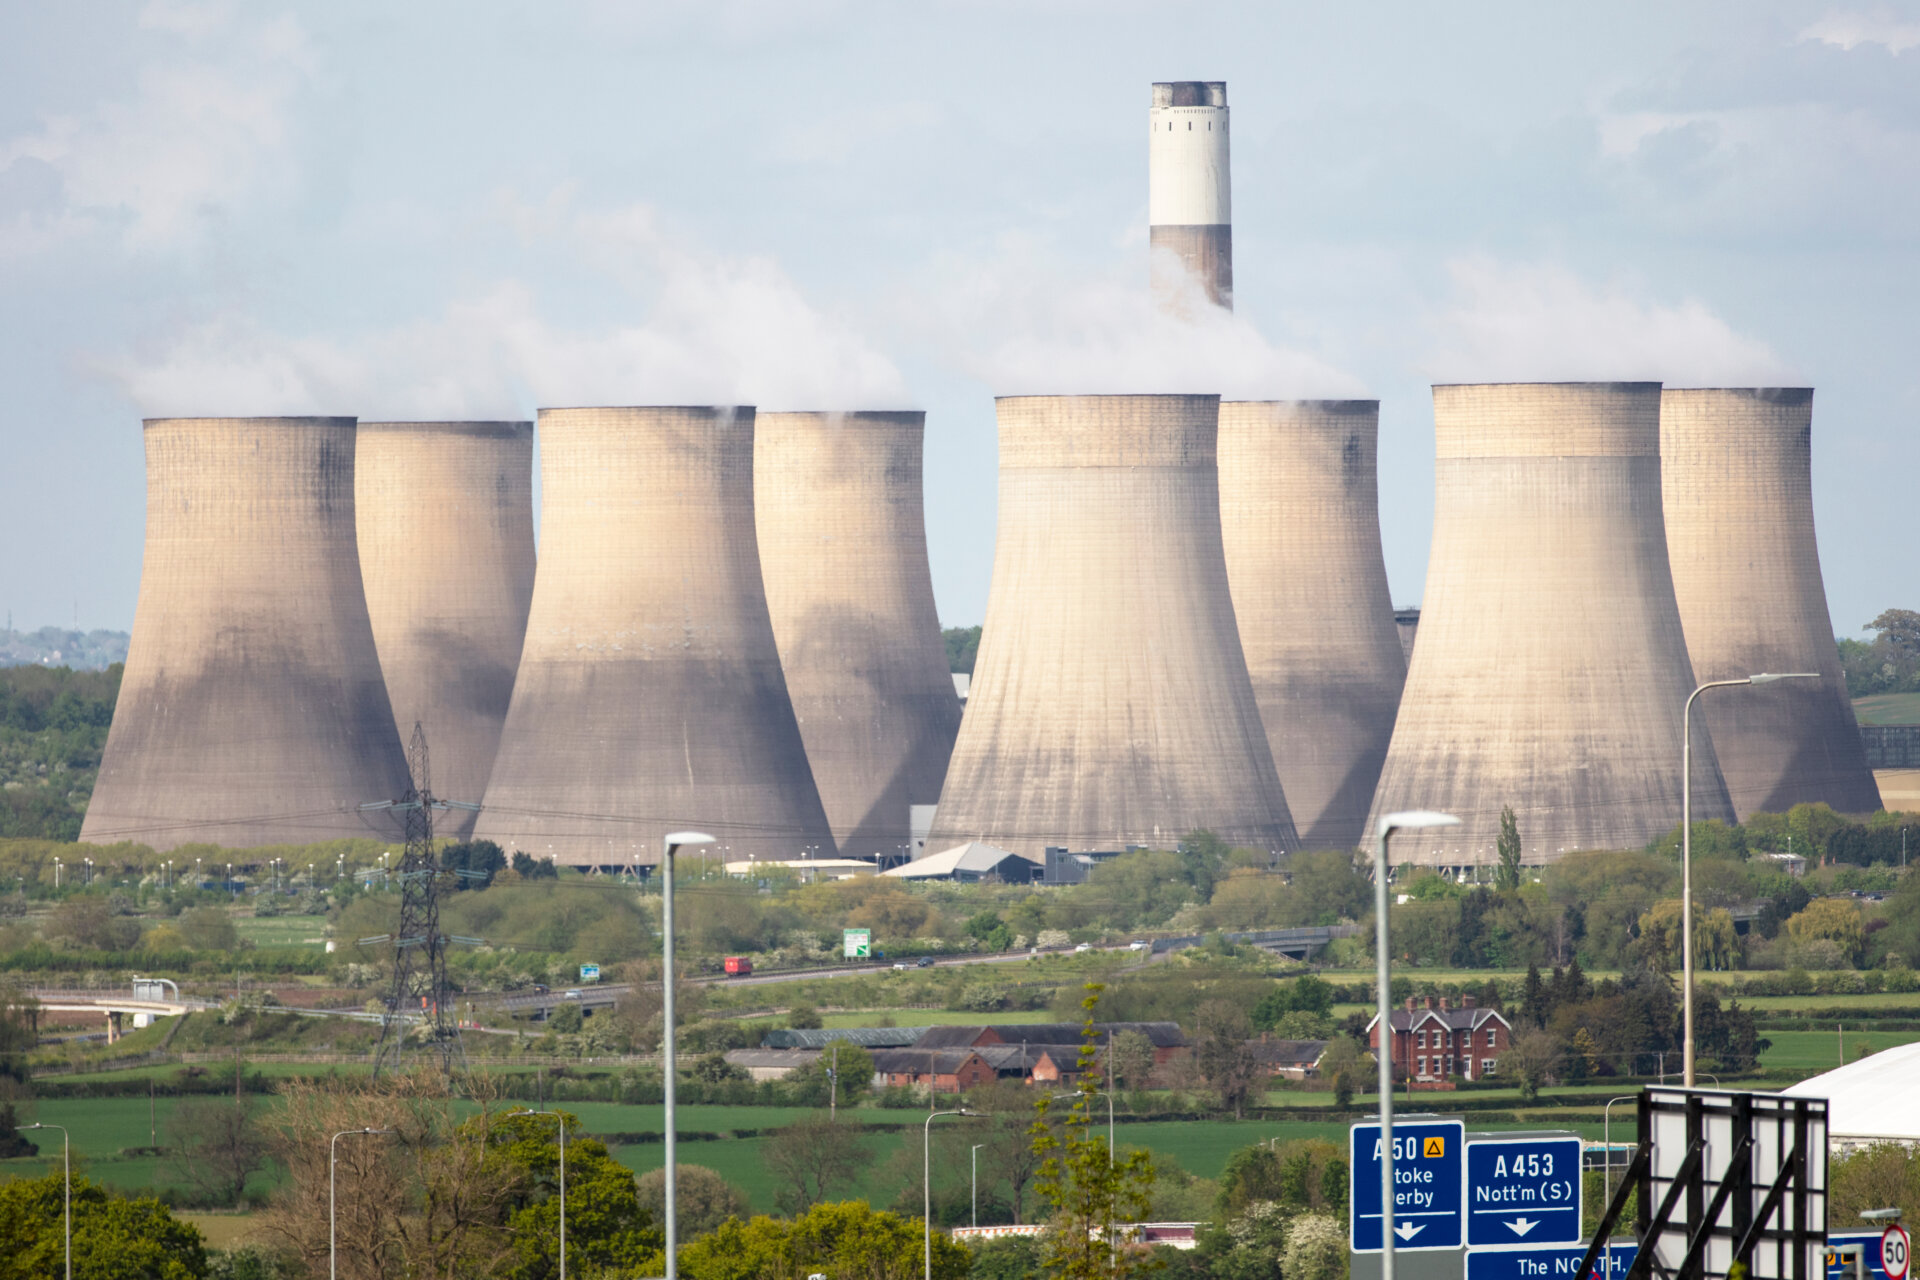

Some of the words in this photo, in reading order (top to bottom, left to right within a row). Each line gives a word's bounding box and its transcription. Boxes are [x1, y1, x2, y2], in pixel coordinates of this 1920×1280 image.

[1394, 1167, 1433, 1184] toke
[1392, 1188, 1434, 1208] erby
[1540, 1180, 1572, 1202] (S)
[1885, 1241, 1905, 1264] 50
[1517, 1258, 1548, 1275] The
[1555, 1255, 1627, 1274] NOTH,
